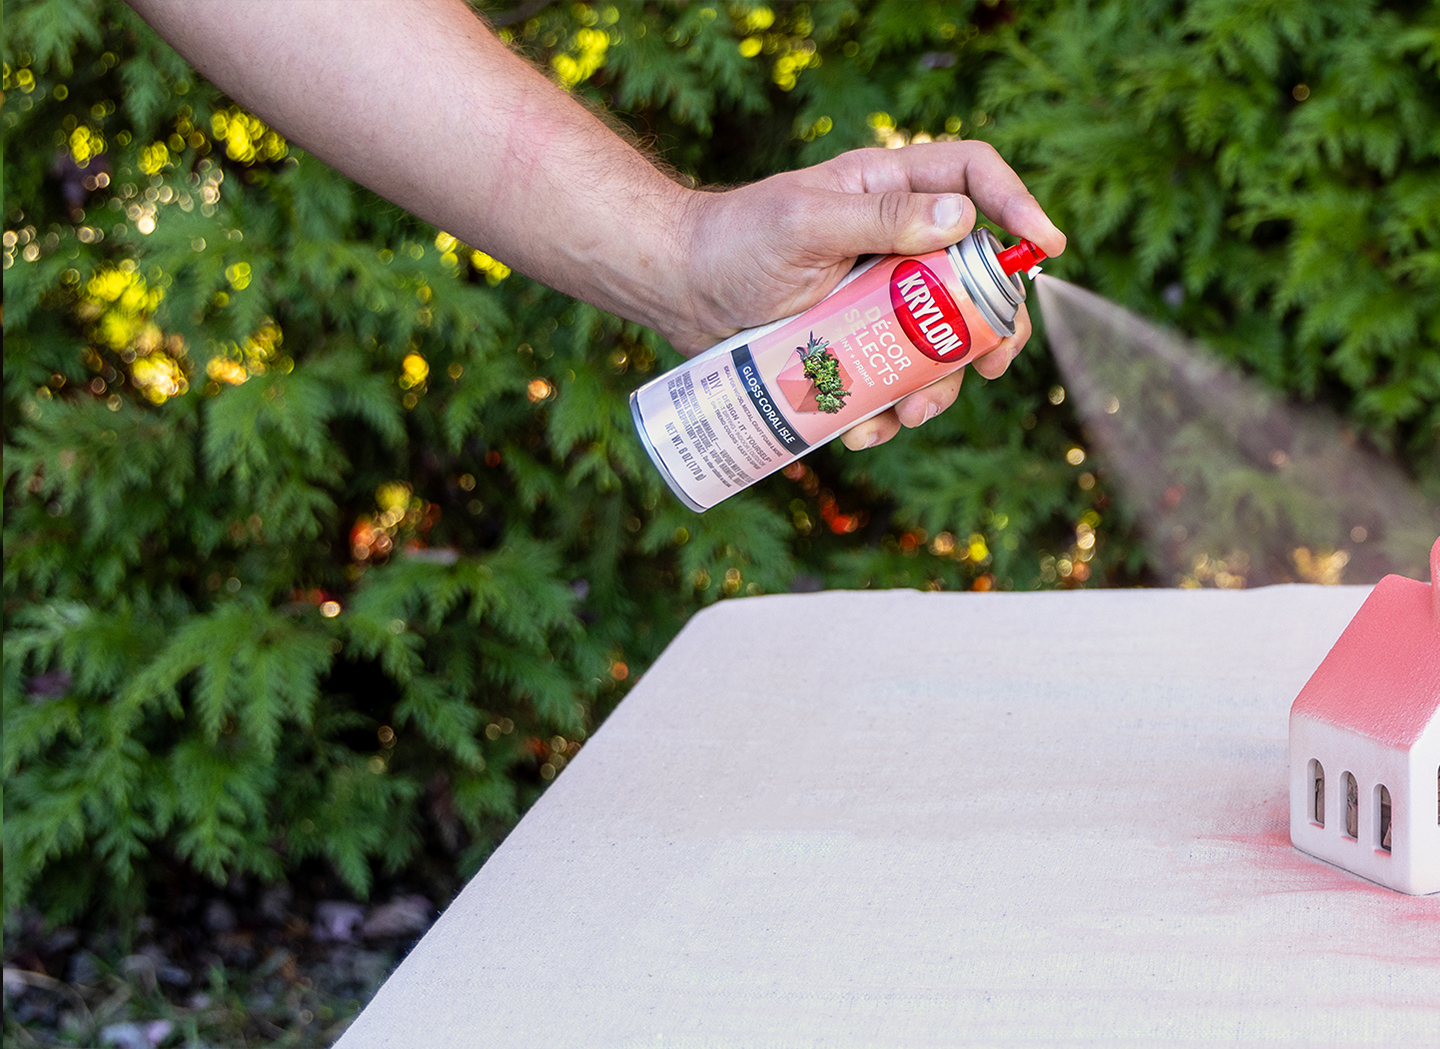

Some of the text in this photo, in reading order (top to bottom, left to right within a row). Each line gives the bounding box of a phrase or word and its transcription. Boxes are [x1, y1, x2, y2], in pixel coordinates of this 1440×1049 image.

[896, 270, 962, 356] KRYLON
[835, 326, 852, 353] PINT
[853, 359, 875, 386] PRIMER
[843, 307, 899, 386] SELECTS
[863, 305, 912, 371] DÉCOR
[706, 371, 722, 390] DIY
[721, 393, 739, 420] DESIGN
[742, 365, 795, 443] GLOSS CORAL ISLE
[664, 421, 677, 437] NET
[722, 410, 735, 429] DRYING
[723, 424, 738, 443] COLORS
[741, 403, 754, 421] METAL,
[751, 420, 764, 435] CRAFT
[670, 434, 684, 449] WT.
[692, 438, 707, 456] TRACT.
[694, 424, 713, 450] PRESSURE.
[709, 449, 723, 464] VAPOR
[685, 459, 702, 475] (170
